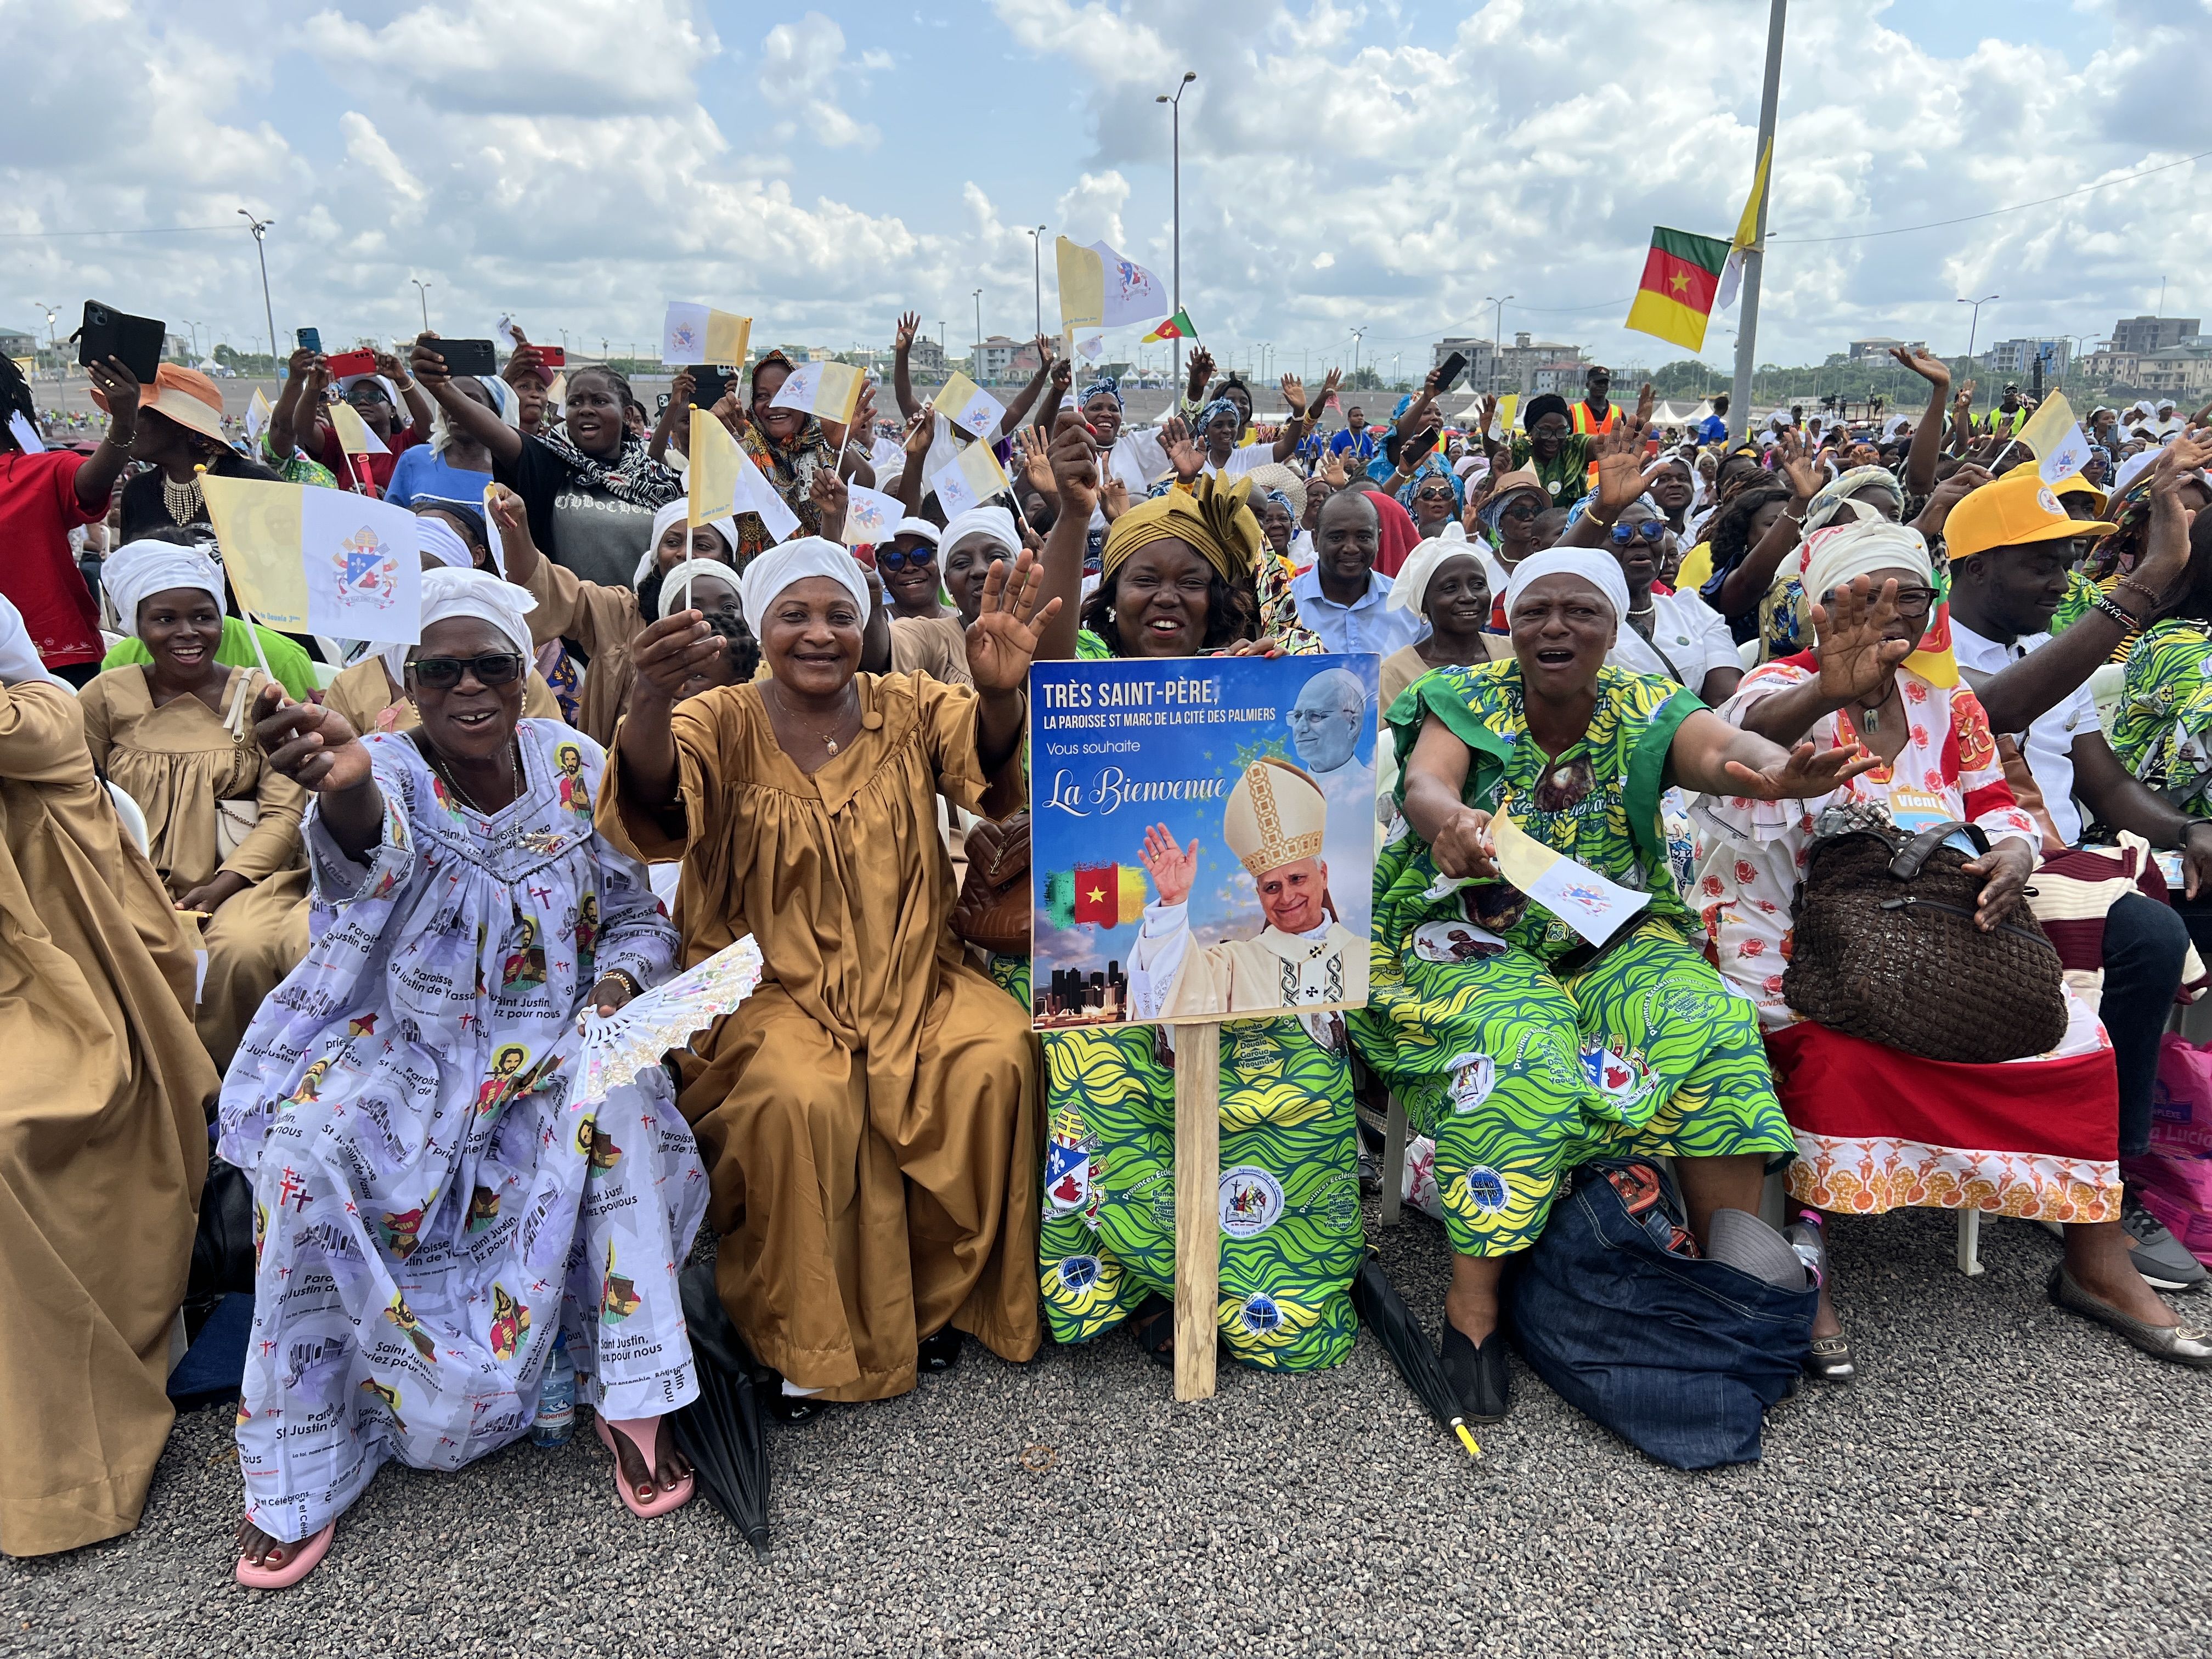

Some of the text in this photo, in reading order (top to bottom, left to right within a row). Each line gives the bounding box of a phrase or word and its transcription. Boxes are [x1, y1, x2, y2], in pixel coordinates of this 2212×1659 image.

[1042, 675, 1219, 708] TRÈS SAINT-PÈRE,
[1044, 707, 1276, 730] LA PAROISSE ST MARC DE LA CITÉ DES PALMIERS
[1046, 740, 1141, 755] Vous souhaite
[1042, 765, 1229, 817] La Bienvenue
[391, 963, 400, 974] St
[398, 971, 425, 992] Justin
[427, 984, 442, 995] de
[413, 967, 453, 986] Paroisse
[566, 985, 574, 996] St
[1658, 986, 1691, 1008] Bamenda
[520, 997, 551, 1008] Justin,
[1667, 991, 1695, 1009] Bertoua
[1681, 1000, 1708, 1018] Garoua
[507, 1010, 534, 1020] pour
[536, 1010, 561, 1019] nous
[1642, 998, 1658, 1036] Provinces
[1231, 1023, 1262, 1032] Bamenda
[1240, 1039, 1268, 1049] Douala
[1514, 1027, 1534, 1070] Provinces
[1240, 1049, 1269, 1059] Garoua
[406, 1066, 439, 1086] Paroiss
[417, 1086, 431, 1095] de
[322, 1125, 334, 1135] St
[468, 1131, 490, 1143] Sain
[661, 1130, 694, 1143] Paroisse
[433, 1146, 453, 1161] prie
[671, 1143, 686, 1153] de
[349, 1138, 376, 1181] Paroisse
[353, 1164, 364, 1175] de
[358, 1177, 373, 1200] Yassa
[1122, 1175, 1155, 1200] Provinces
[1327, 1189, 1357, 1199] Bamenda
[1299, 1182, 1329, 1214] Provinces
[471, 1216, 520, 1252] aint Justin,
[487, 1235, 510, 1256] pour
[426, 1254, 442, 1263] de
[278, 1285, 321, 1305] St Justin
[601, 1334, 649, 1350] Saint Justin,
[375, 1341, 436, 1380] Saint Justin,
[611, 1344, 663, 1364] pour nous
[391, 1358, 419, 1373] pour
[420, 1373, 443, 1392] nous
[481, 1363, 491, 1373] St
[276, 1427, 286, 1440] St
[290, 1423, 327, 1436] Justin
